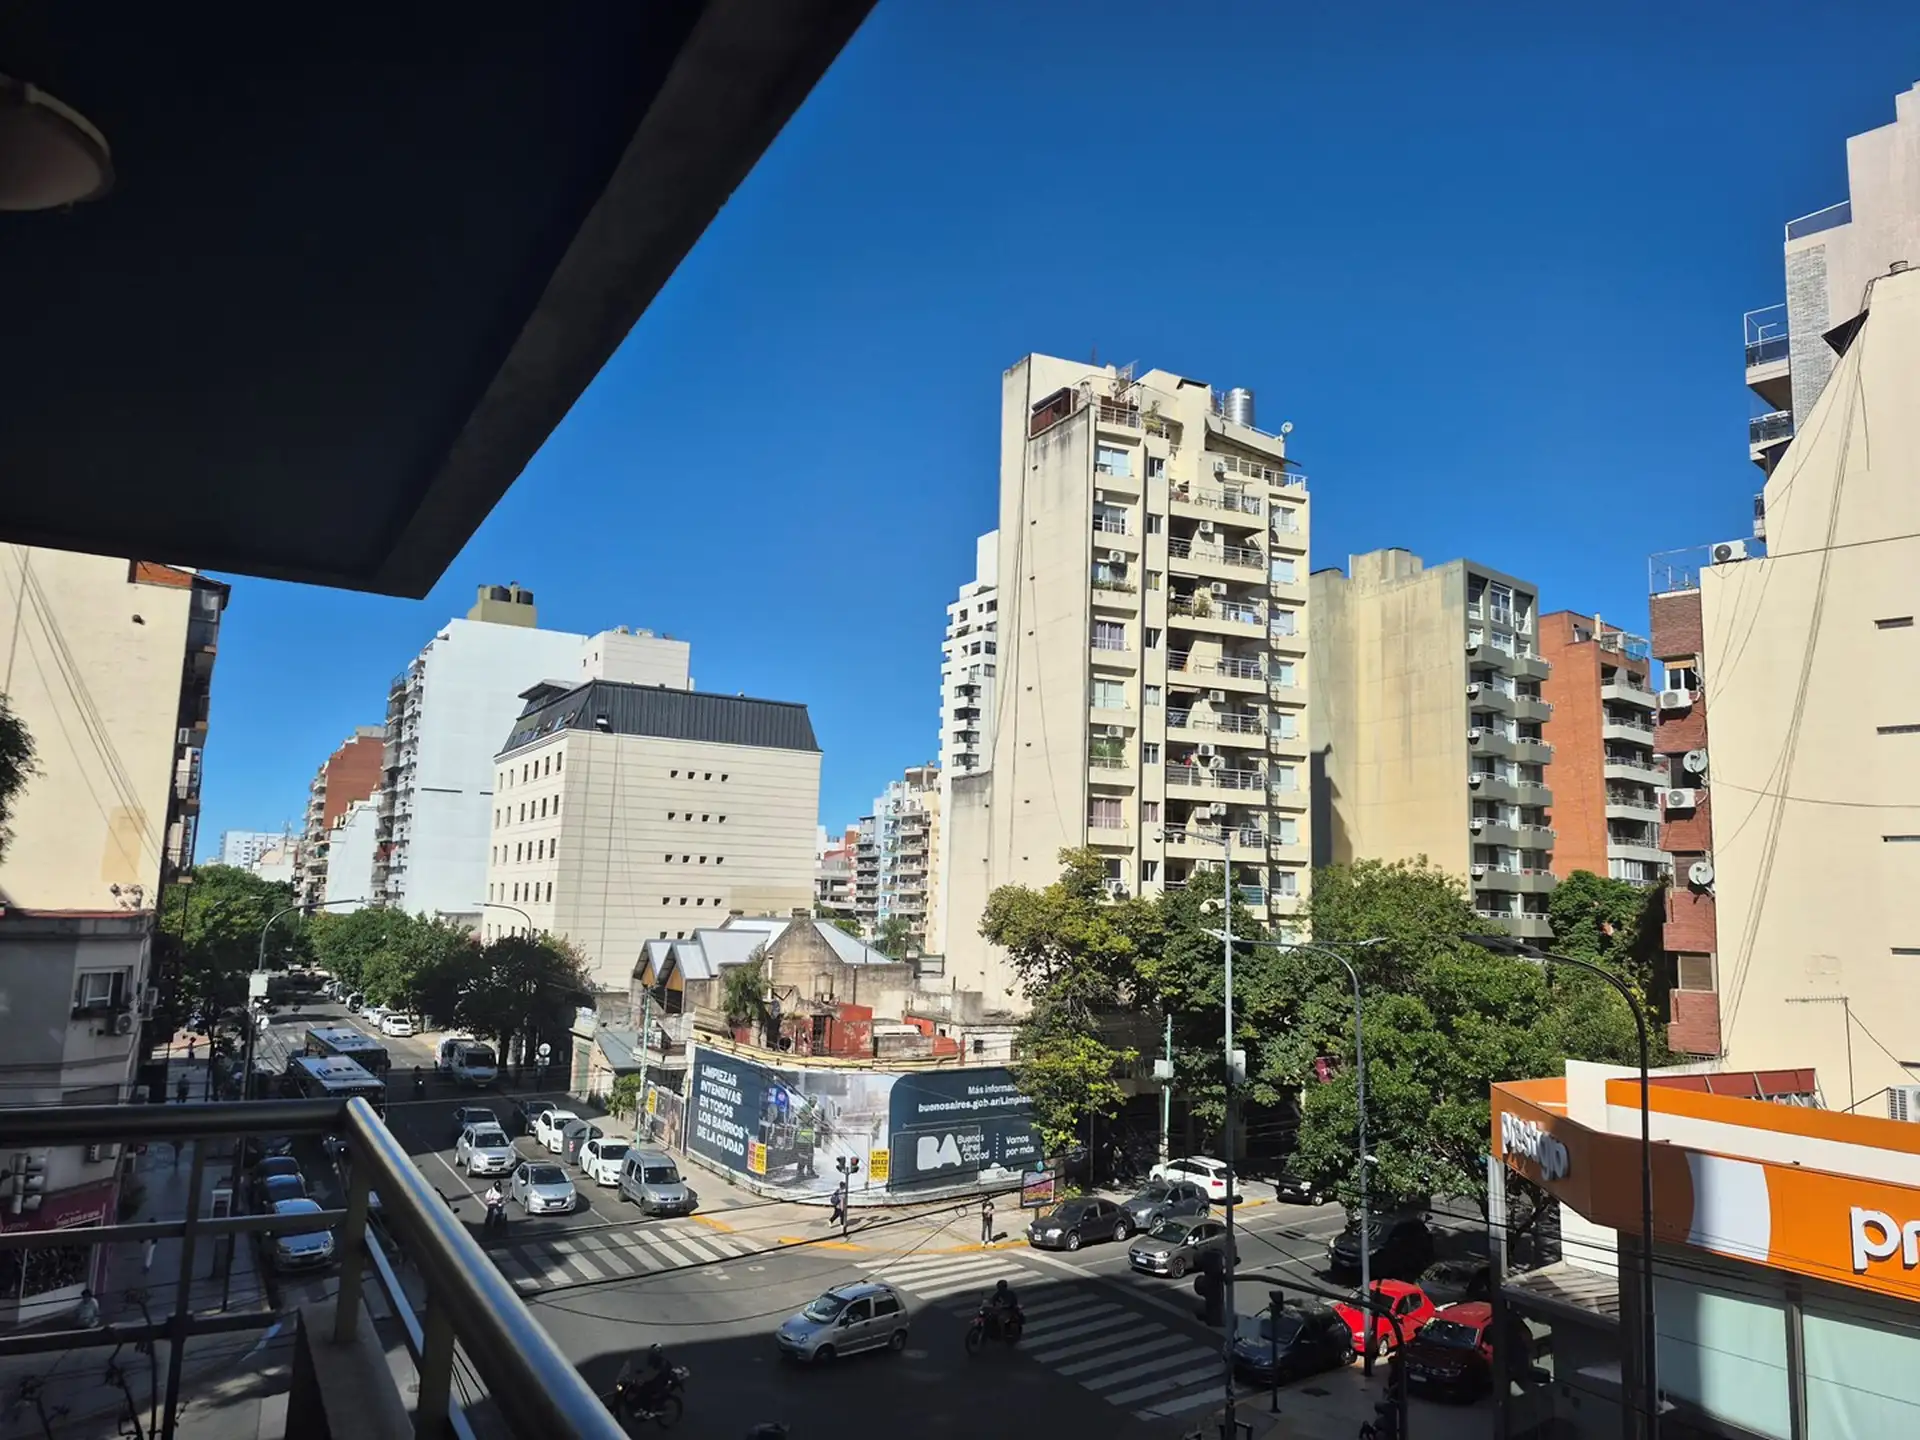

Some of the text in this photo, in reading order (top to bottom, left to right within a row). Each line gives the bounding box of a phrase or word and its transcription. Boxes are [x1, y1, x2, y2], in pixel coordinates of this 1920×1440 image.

[702, 1064, 737, 1087] LIMPIEZAS
[700, 1080, 742, 1105] INTENSIVAS
[699, 1094, 734, 1118] EN TODOS
[698, 1110, 744, 1139] LOS BARRIOS
[696, 1124, 744, 1156] DE LA CIUDAD
[957, 1134, 984, 1144] Buenos
[961, 1143, 980, 1153] Aires
[1005, 1135, 1029, 1145] Vamos
[917, 1133, 962, 1171] BA
[963, 1150, 989, 1161] Ciudad
[1005, 1147, 1019, 1159] por
